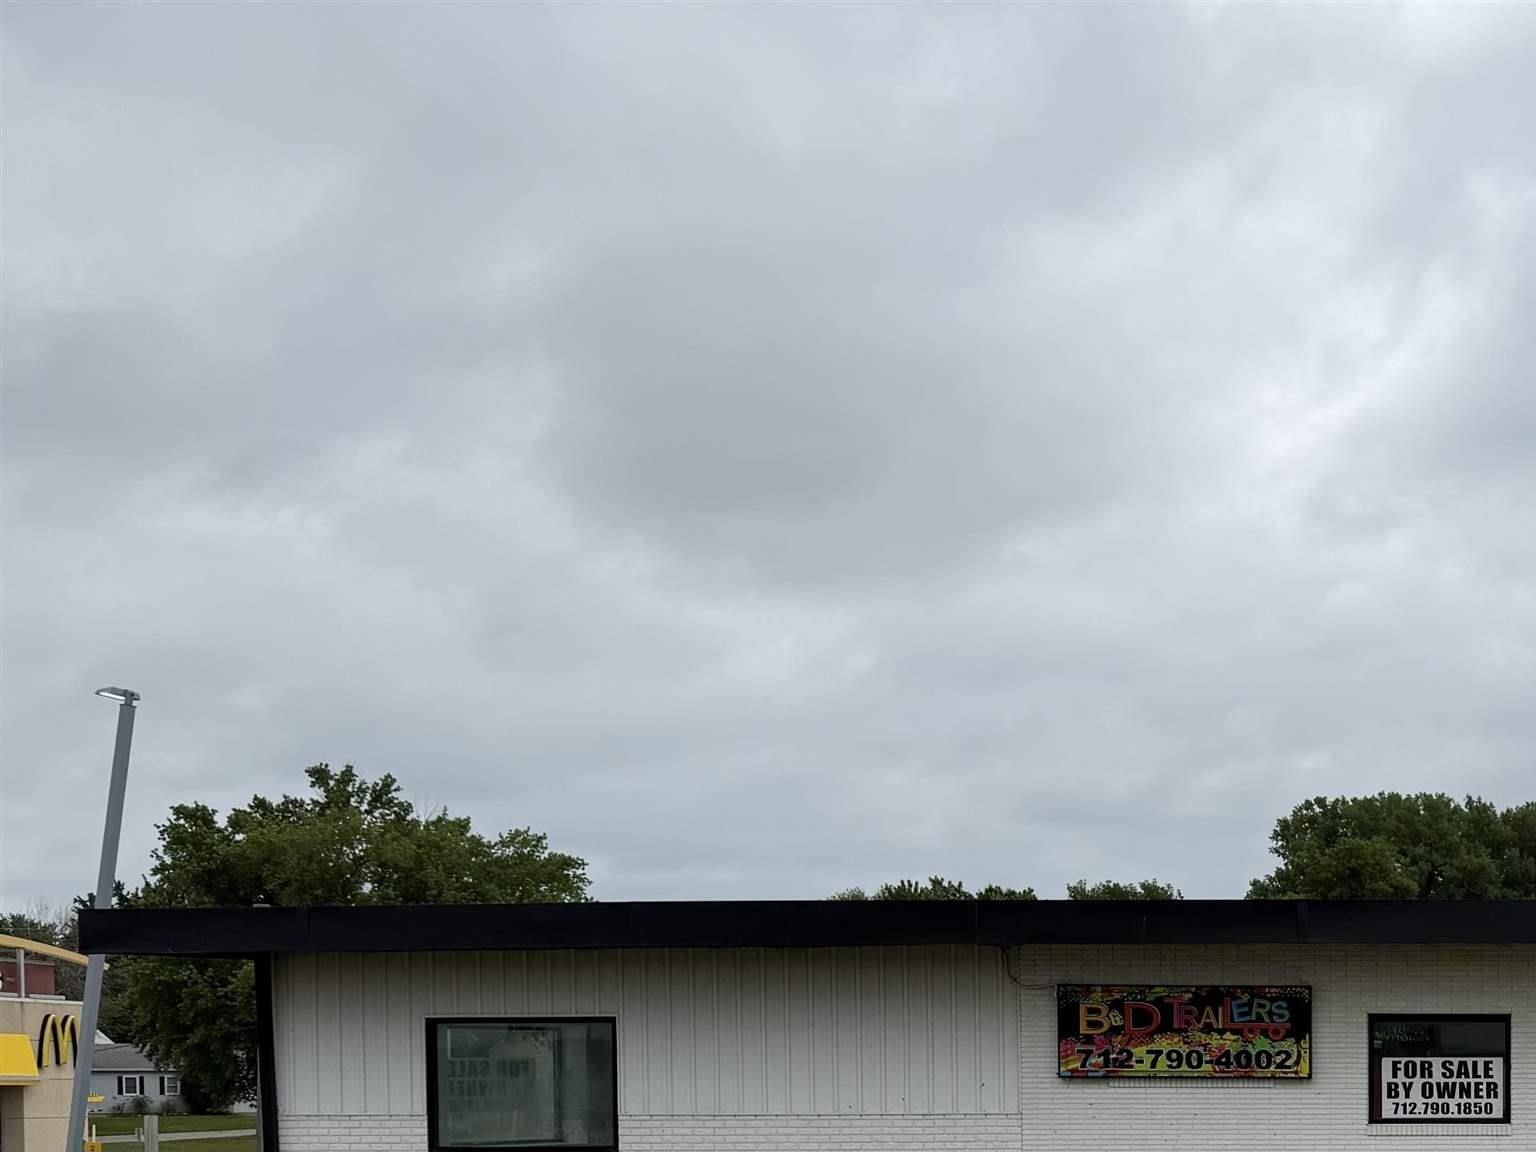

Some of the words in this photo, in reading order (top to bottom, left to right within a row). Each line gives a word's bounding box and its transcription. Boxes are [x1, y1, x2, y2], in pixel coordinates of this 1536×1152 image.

[1075, 1048, 1293, 1071] 712-790-4002
[1391, 1060, 1434, 1079] FOR
[1441, 1060, 1494, 1079] SALE
[1386, 1081, 1414, 1100] BY
[1421, 1081, 1499, 1100] OWNER
[1392, 1102, 1494, 1115] 712.790.1850
